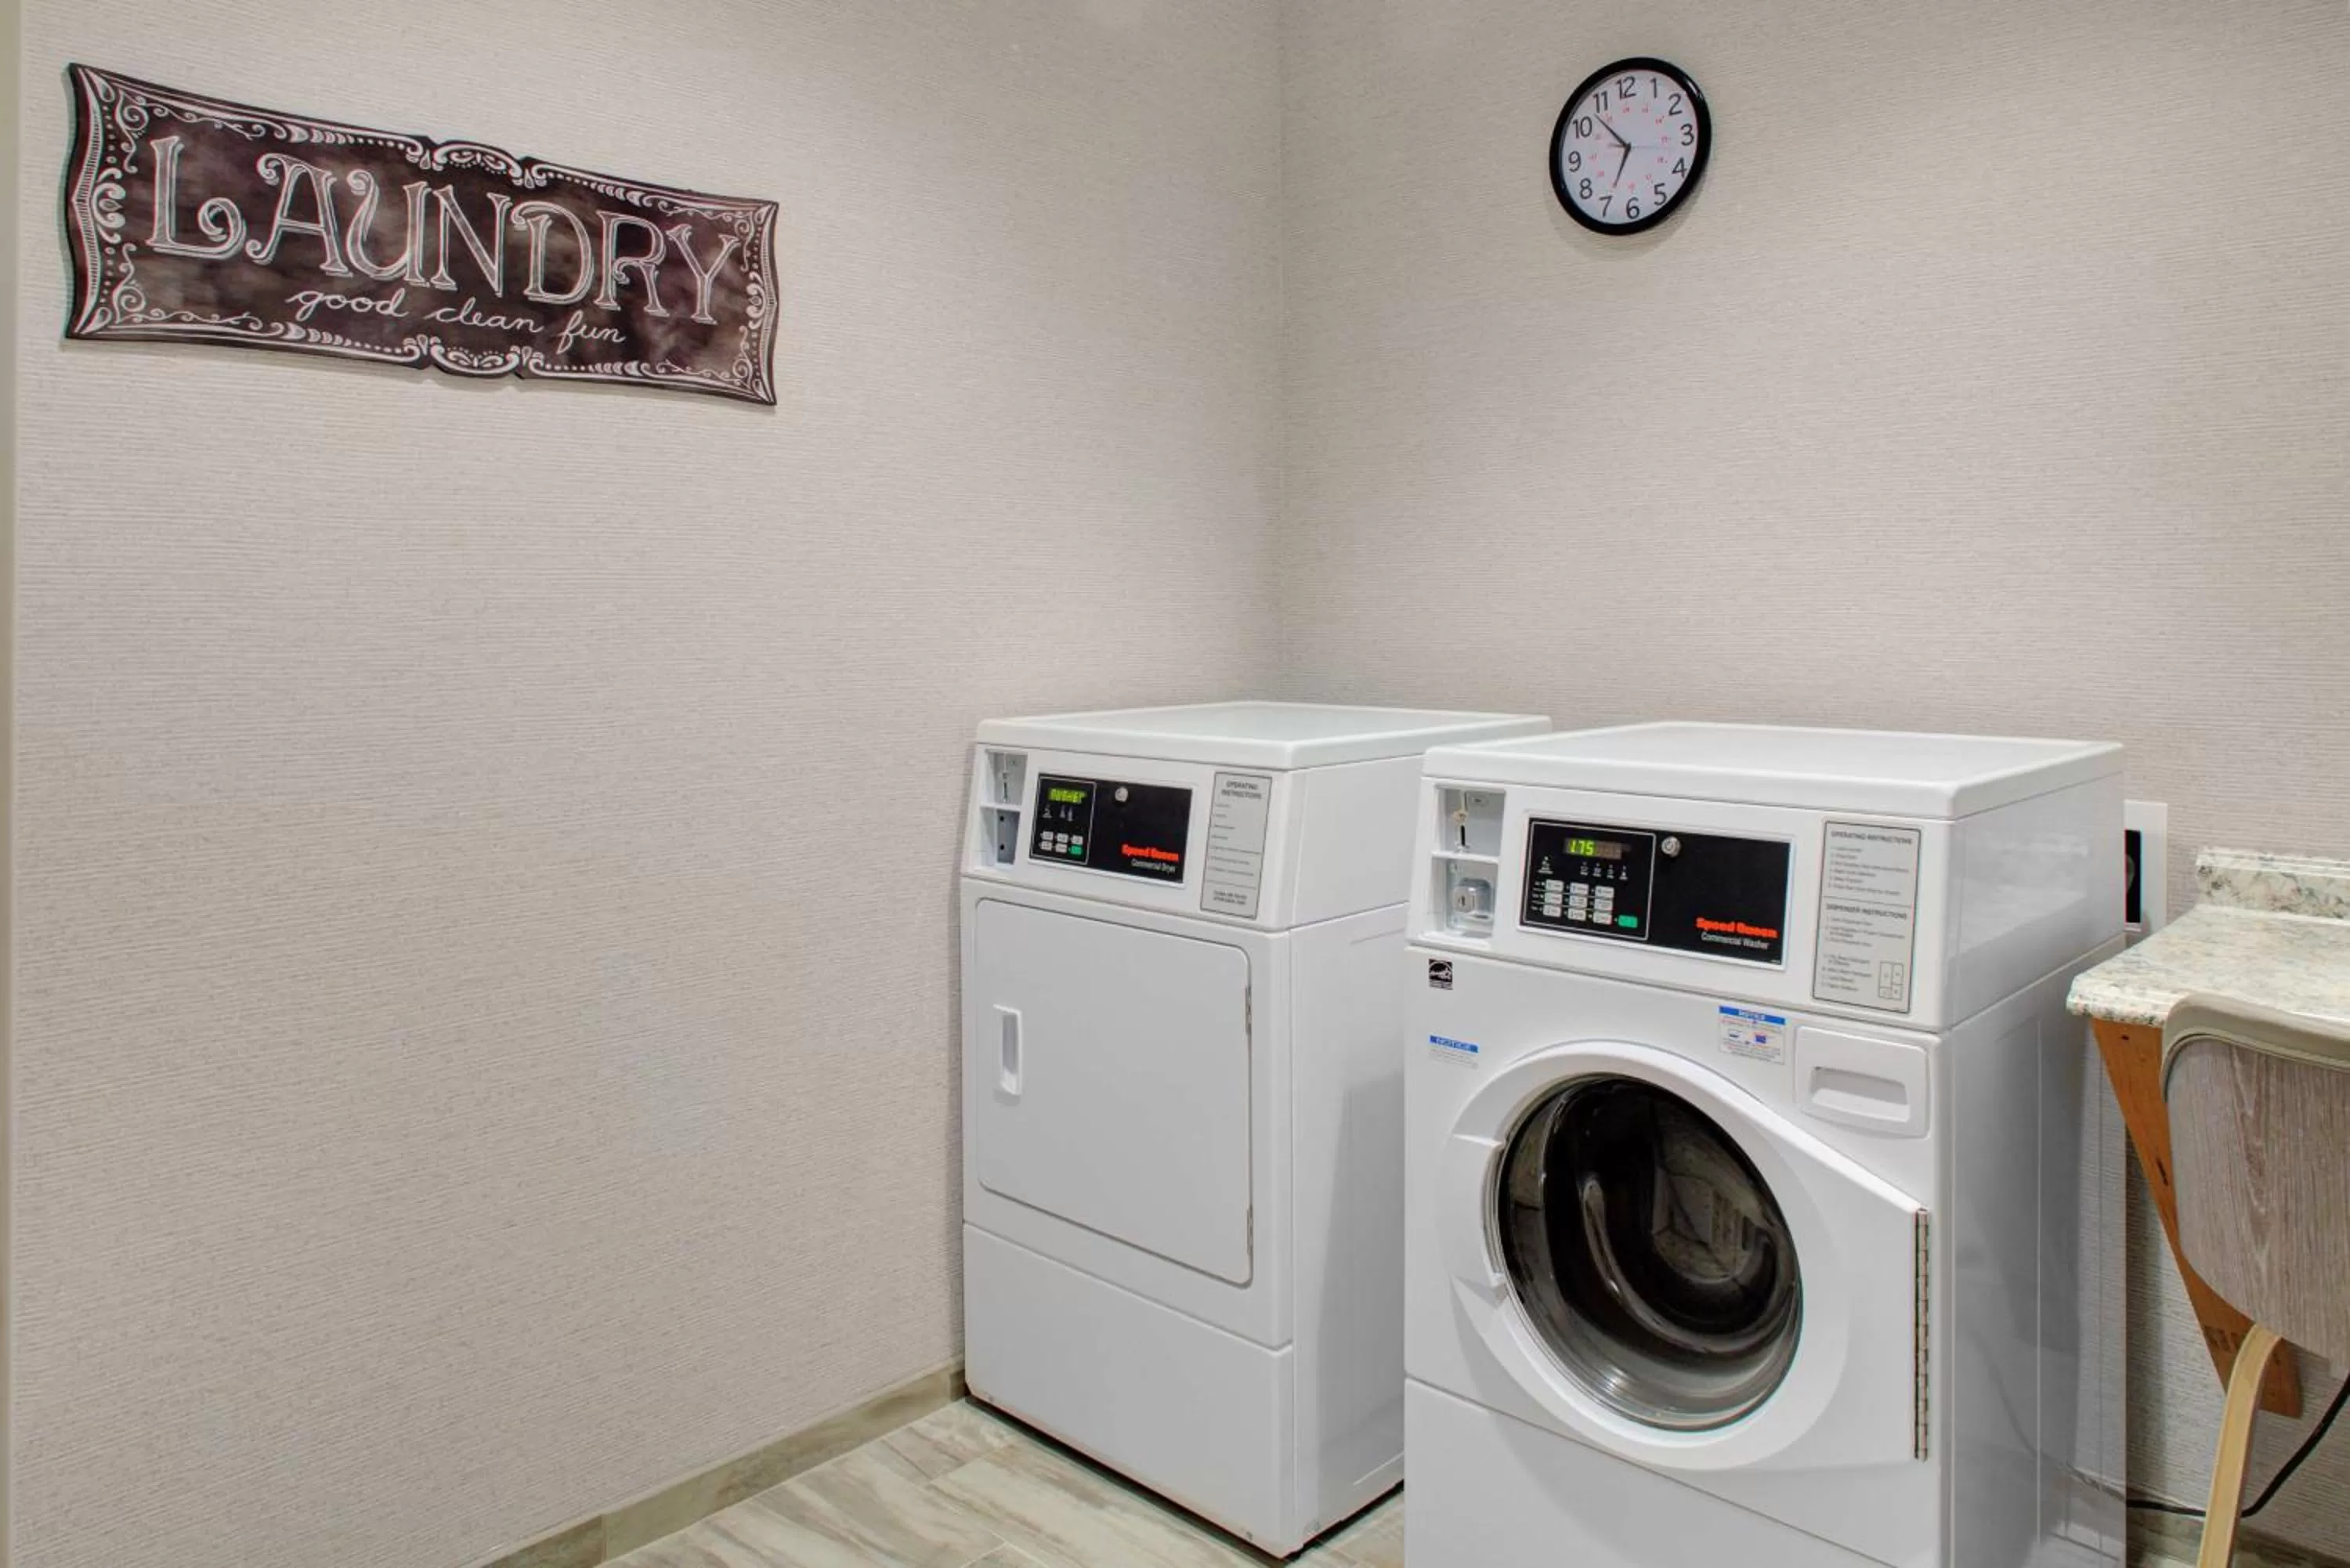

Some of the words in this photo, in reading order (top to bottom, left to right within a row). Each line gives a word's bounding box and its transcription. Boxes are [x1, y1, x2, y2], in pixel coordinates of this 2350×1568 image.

[1616, 76, 1636, 100] 12
[1650, 78, 1658, 99] 1
[1593, 91, 1608, 113] 11
[1668, 92, 1683, 116] 2
[1572, 116, 1593, 139] 10
[1679, 123, 1694, 146] 3
[1567, 150, 1582, 172] 9
[1672, 157, 1687, 179] 4
[1578, 178, 1593, 200] 8
[1654, 182, 1667, 205] 5
[1599, 195, 1612, 218] 7
[1625, 197, 1640, 219] 6
[146, 135, 742, 325] LAUNDRY
[287, 287, 408, 323] good
[423, 297, 544, 335] clean
[557, 310, 627, 354] fun
[1122, 844, 1149, 857] Speed
[1696, 917, 1735, 931] Speed
[1737, 922, 1778, 938] Queen
[1701, 931, 1741, 945] Commercial
[1743, 938, 1770, 950] Washer
